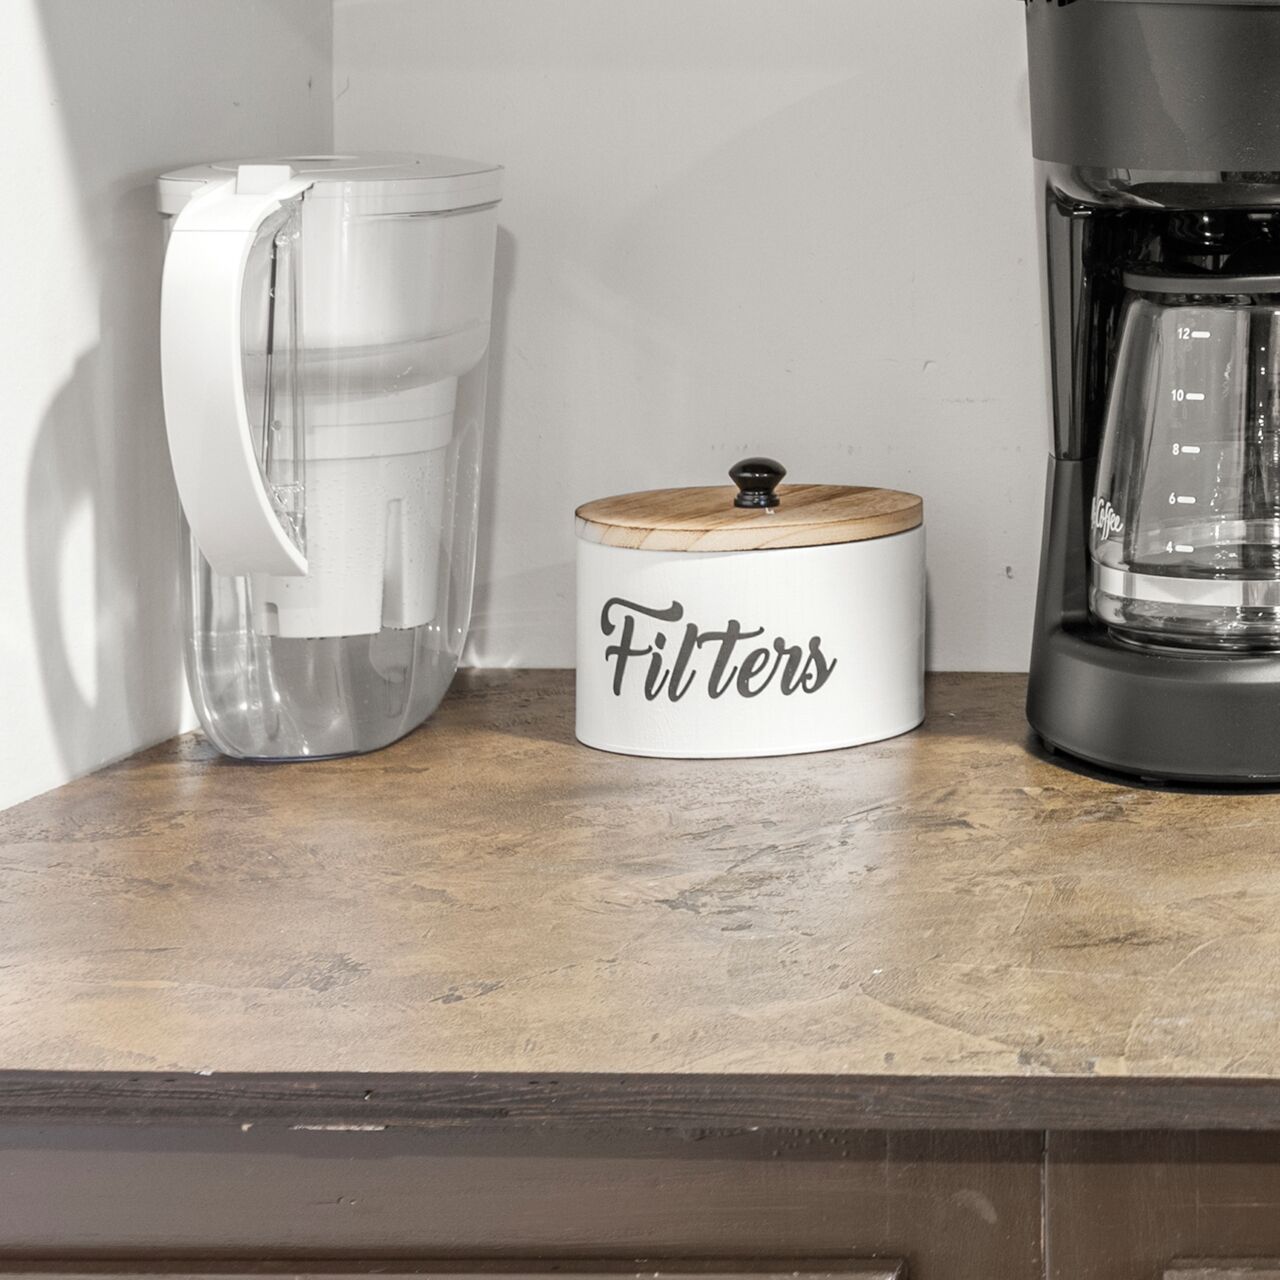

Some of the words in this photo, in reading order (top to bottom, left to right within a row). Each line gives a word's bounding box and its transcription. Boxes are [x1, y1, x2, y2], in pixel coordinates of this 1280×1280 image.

[1177, 328, 1190, 340] 12
[1171, 389, 1184, 401] 10
[1172, 443, 1180, 455] 8
[1168, 492, 1176, 505] 6
[1166, 541, 1173, 553] 4
[601, 597, 837, 703] Filters
